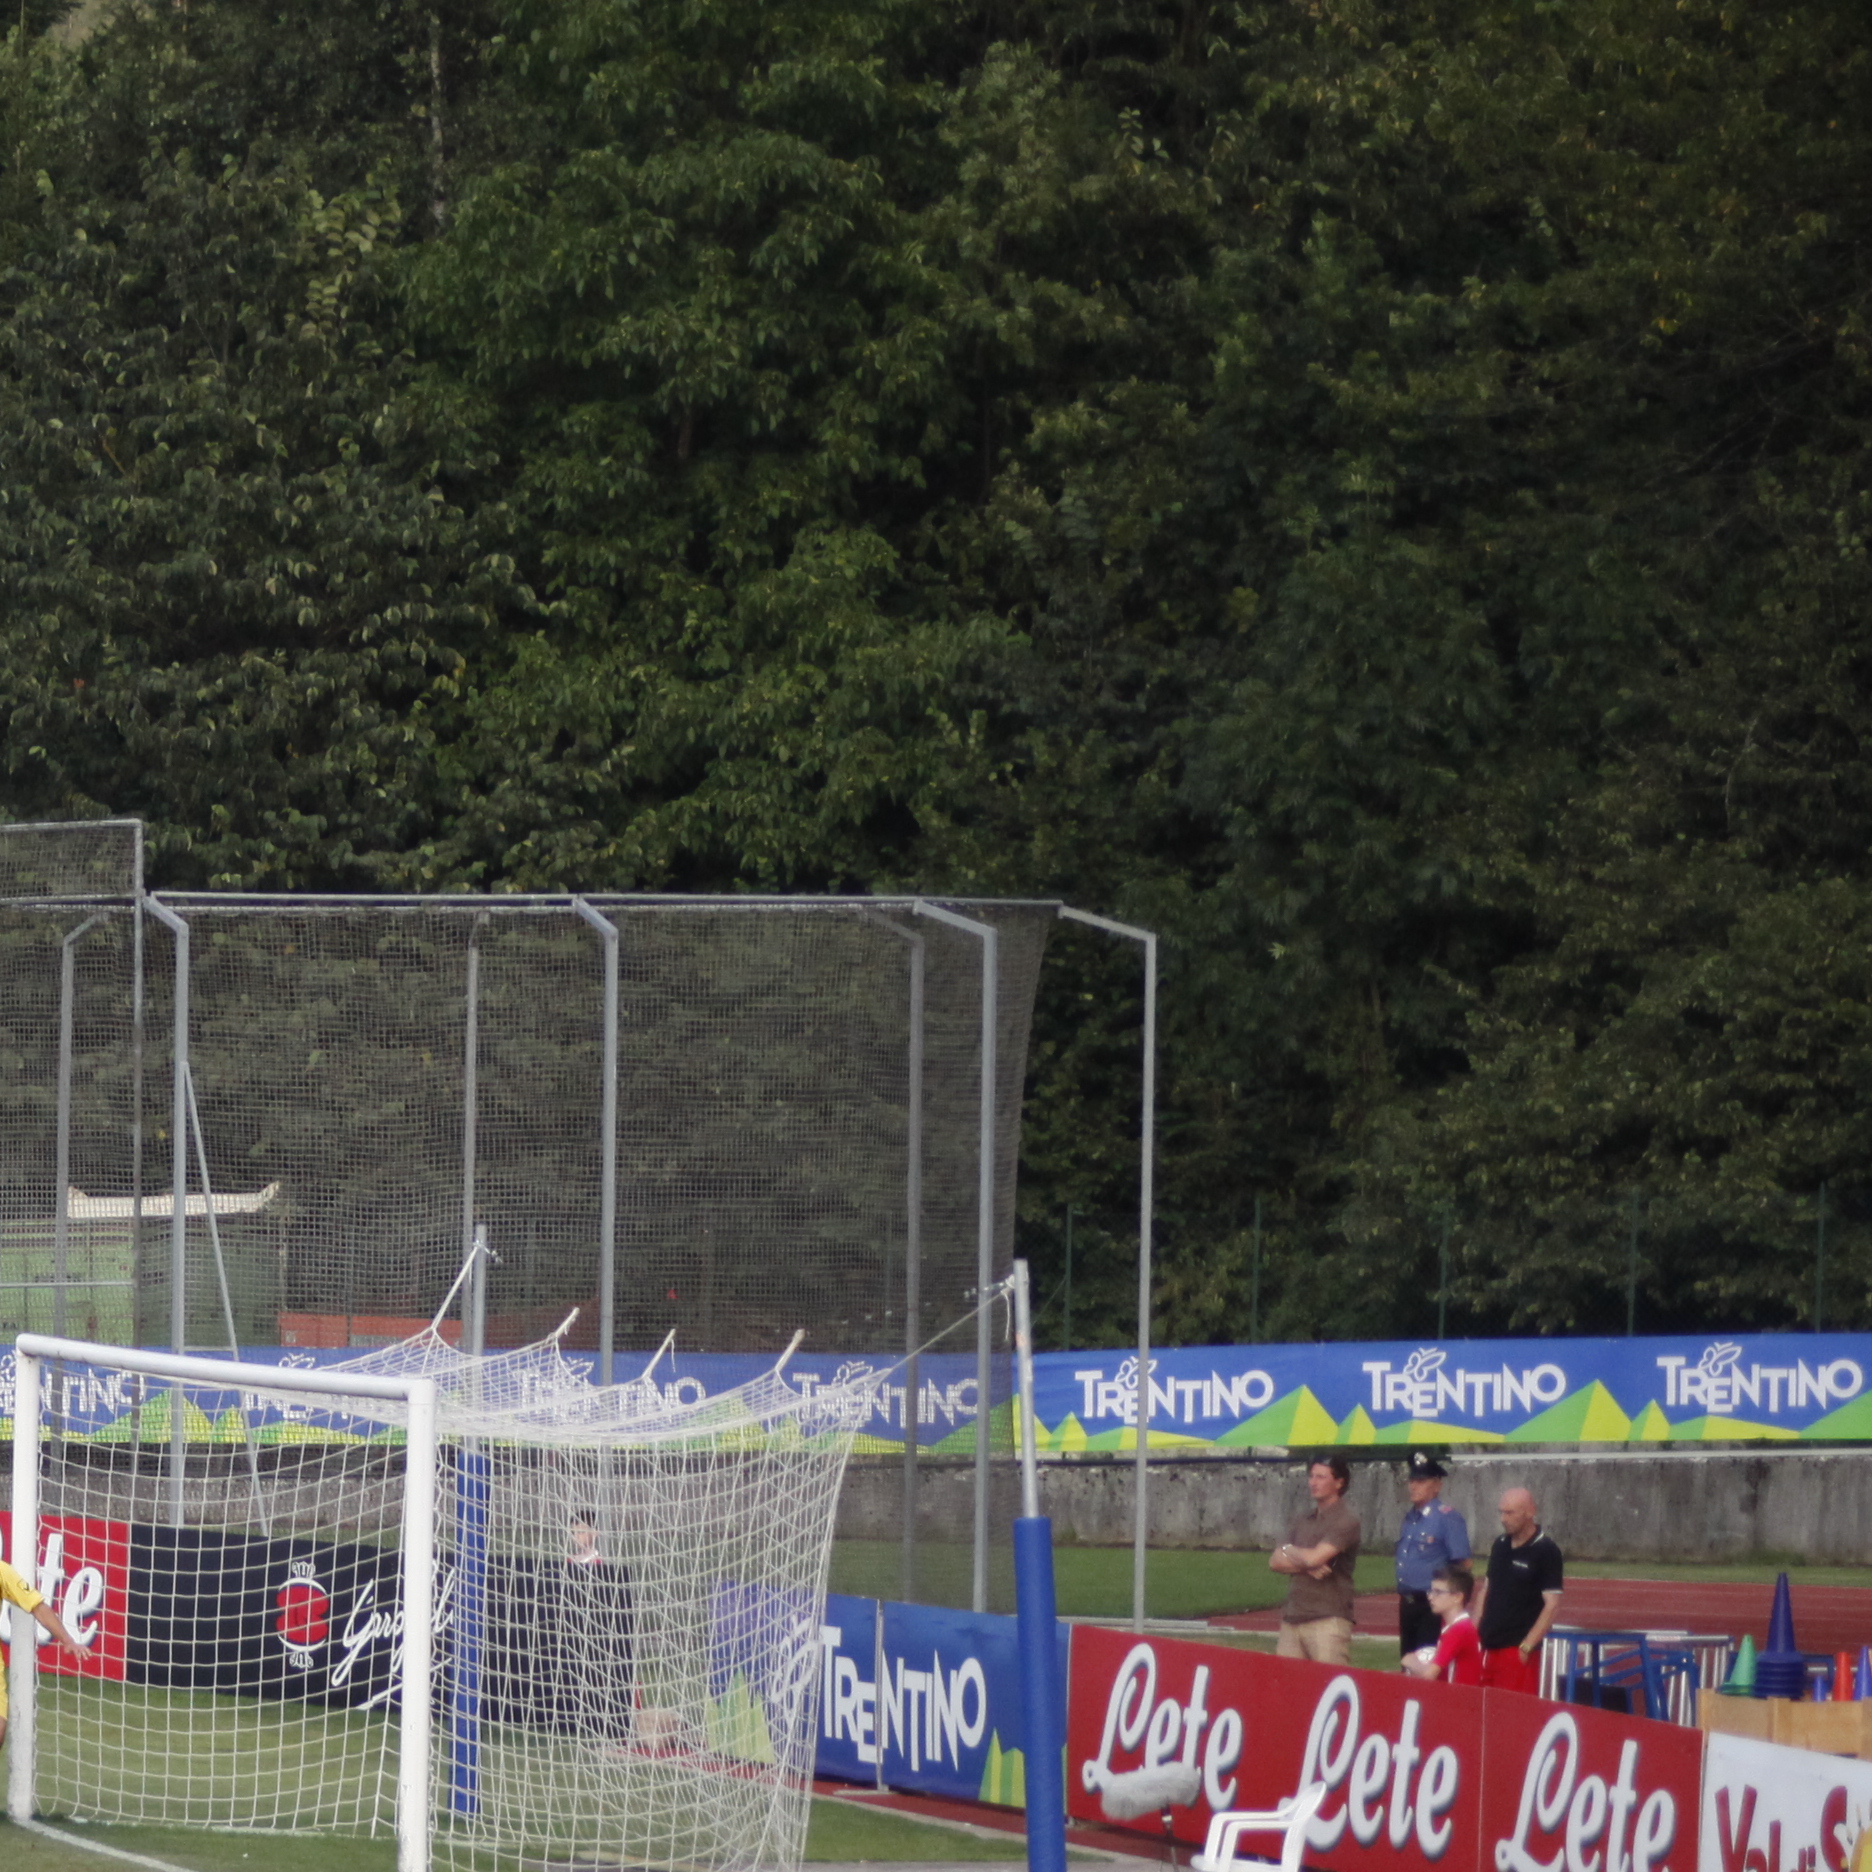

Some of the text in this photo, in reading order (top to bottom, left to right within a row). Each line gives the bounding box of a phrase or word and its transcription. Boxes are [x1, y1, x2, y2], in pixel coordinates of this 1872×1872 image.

[1074, 1370, 1274, 1424] TRENTINO
[1362, 1361, 1567, 1417] TRENTINO
[1657, 1356, 1864, 1413] TRENTINO
[819, 1625, 987, 1772] TRENTINO
[1082, 1643, 1243, 1812] Lete
[1277, 1674, 1458, 1861] Lete
